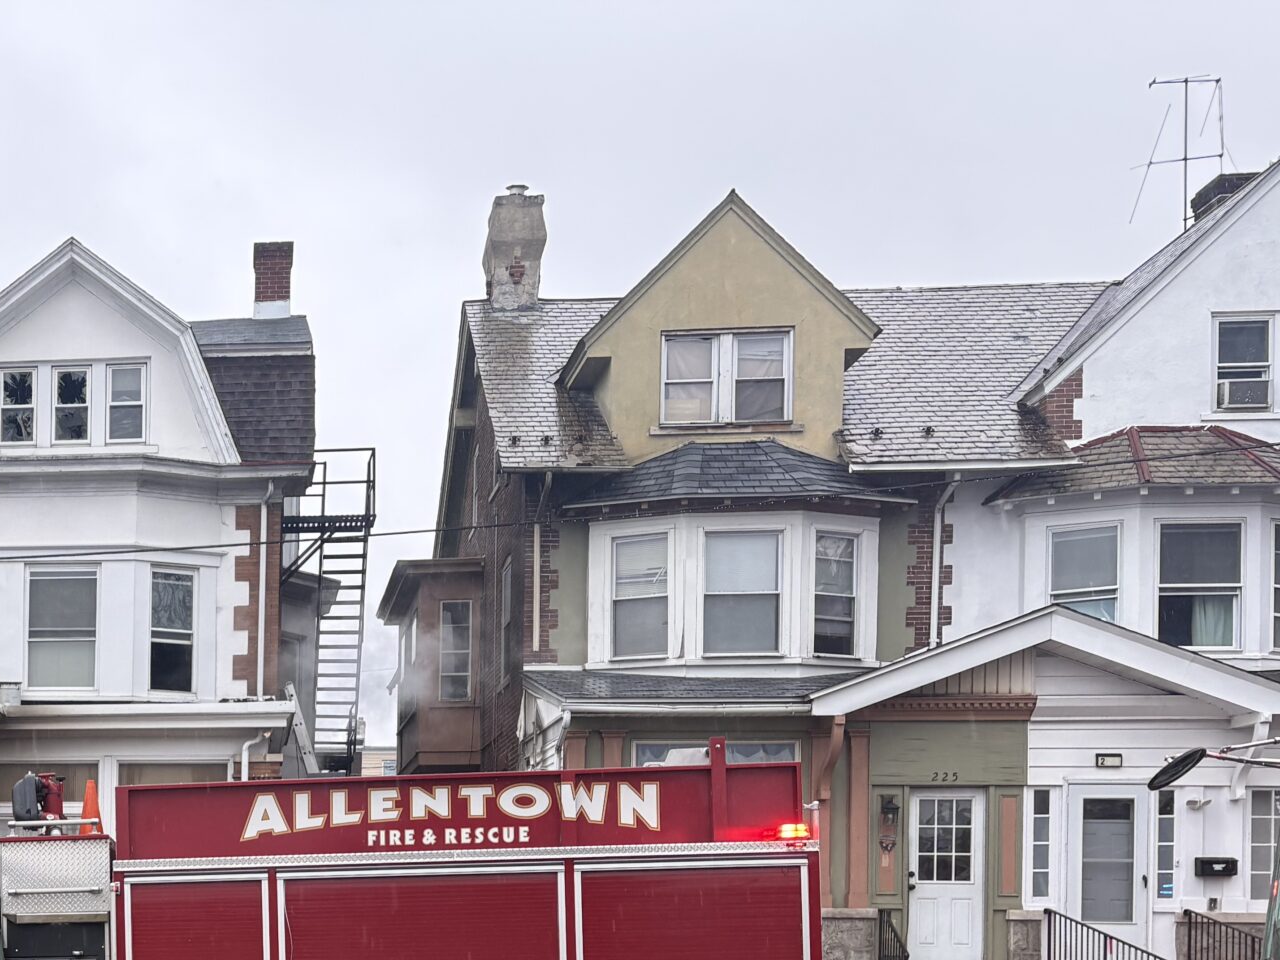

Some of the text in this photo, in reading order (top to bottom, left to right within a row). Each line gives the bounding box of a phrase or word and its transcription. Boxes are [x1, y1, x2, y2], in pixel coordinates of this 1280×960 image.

[931, 771, 959, 782] 225
[240, 780, 660, 842] ALLENTOWN
[367, 826, 530, 846] FIRE & RESCUE
